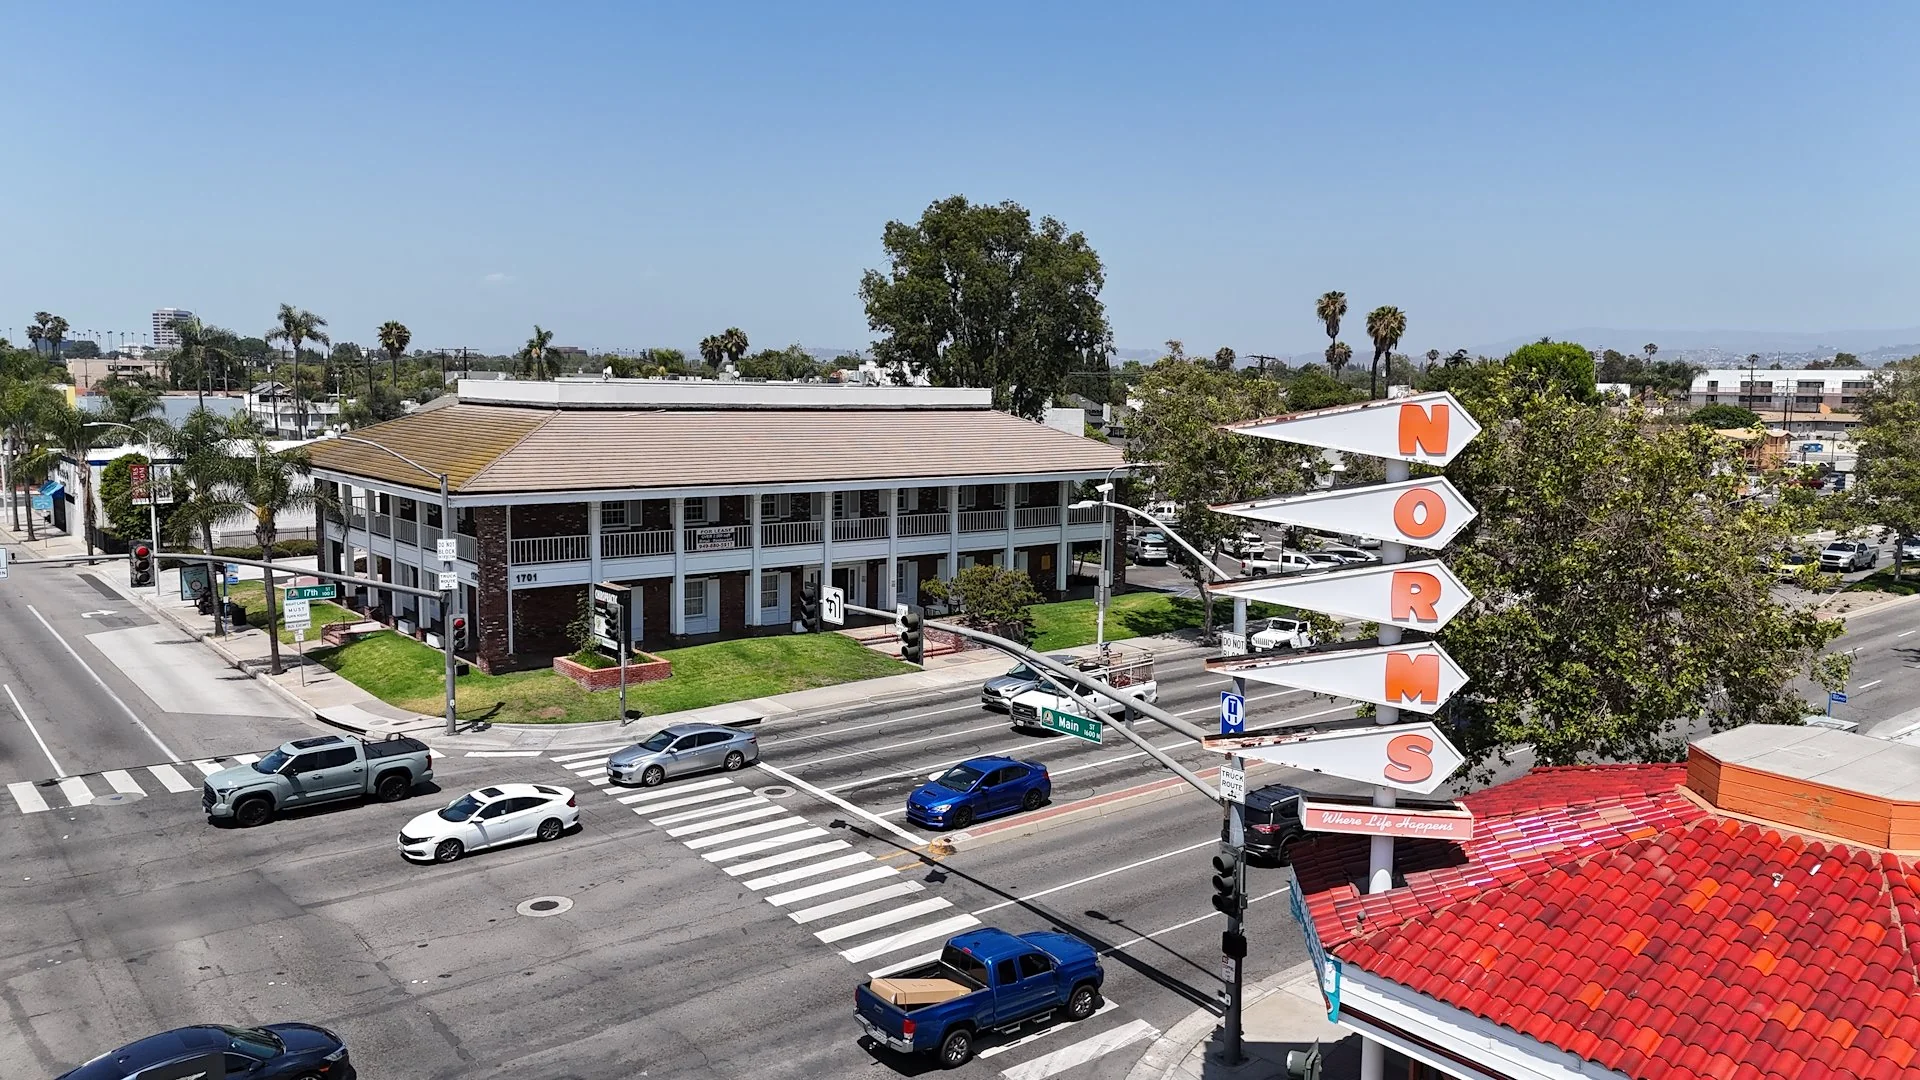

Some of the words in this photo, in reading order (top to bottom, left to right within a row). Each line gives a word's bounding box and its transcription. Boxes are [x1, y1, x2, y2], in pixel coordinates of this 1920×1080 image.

[516, 573, 537, 583] 1701
[303, 589, 318, 597] 17th
[1223, 637, 1231, 647] DO
[1232, 639, 1244, 650] NOT
[1058, 716, 1079, 732] Main
[1083, 730, 1095, 738] 1600
[1222, 771, 1243, 782] TRUCK
[1222, 780, 1243, 791] ROUTE
[1321, 811, 1362, 826] Where
[1365, 815, 1392, 831] Life
[1395, 817, 1454, 834] Happens
